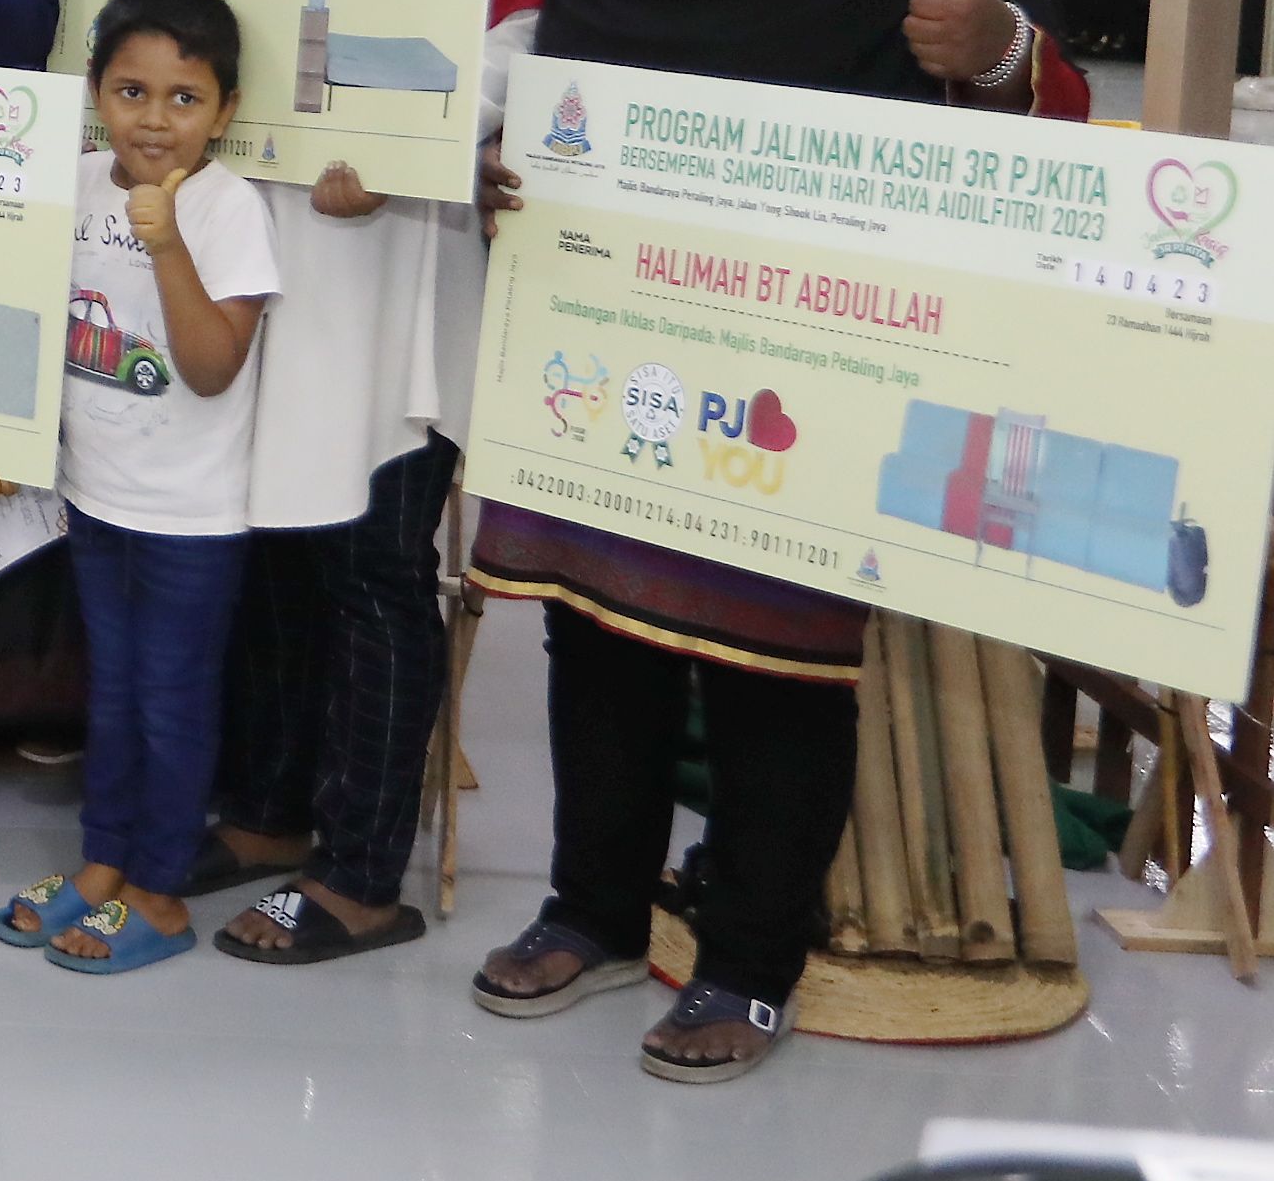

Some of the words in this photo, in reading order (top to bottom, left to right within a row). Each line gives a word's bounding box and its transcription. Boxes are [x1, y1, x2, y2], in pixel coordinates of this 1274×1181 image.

[619, 144, 715, 179] BERSEMPENA
[721, 157, 823, 197] SAMBUTAN
[828, 173, 874, 205] HARI
[880, 181, 928, 214] RAYA
[935, 189, 1044, 232] AIDILFITRI
[1050, 206, 1104, 241] 2023
[624, 103, 744, 153] PROGRAM
[749, 120, 862, 170] JALINAN
[870, 136, 953, 183] KASIH
[962, 149, 999, 190] 3R
[1008, 154, 1106, 206] PJKITA
[635, 243, 748, 297] HALIMAH
[756, 264, 790, 304] BT
[794, 273, 942, 334] ABDULLAH
[625, 386, 679, 418] SISA
[697, 390, 746, 438] PJ
